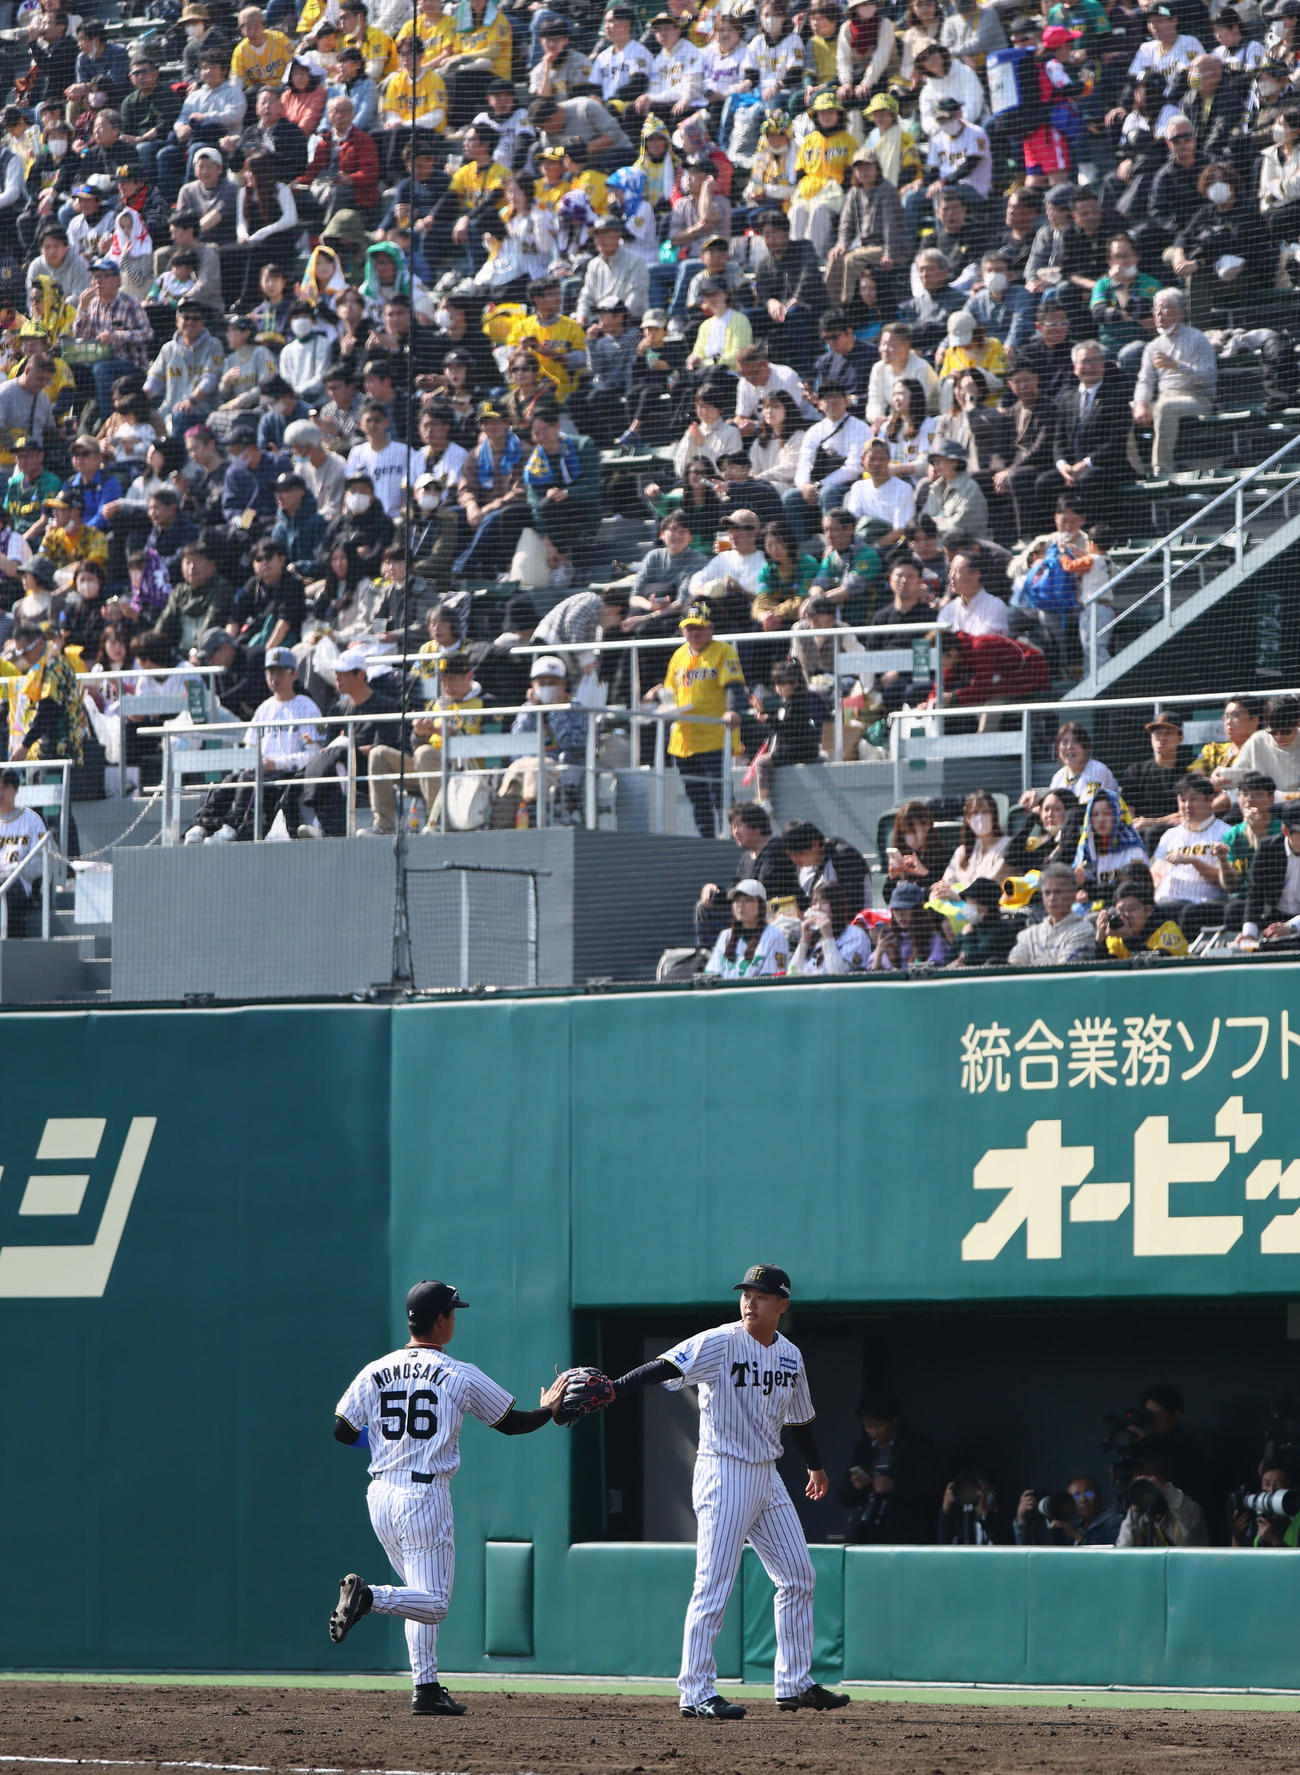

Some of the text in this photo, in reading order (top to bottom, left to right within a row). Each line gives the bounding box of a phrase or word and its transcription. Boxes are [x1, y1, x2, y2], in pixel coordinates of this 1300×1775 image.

[960, 1009, 1300, 1094] 統合業務ソフト
[0, 1116, 158, 1298] シ
[371, 1362, 451, 1389] MOMOSAKI
[731, 1361, 800, 1396] Tigers
[380, 1389, 439, 1440] 56
